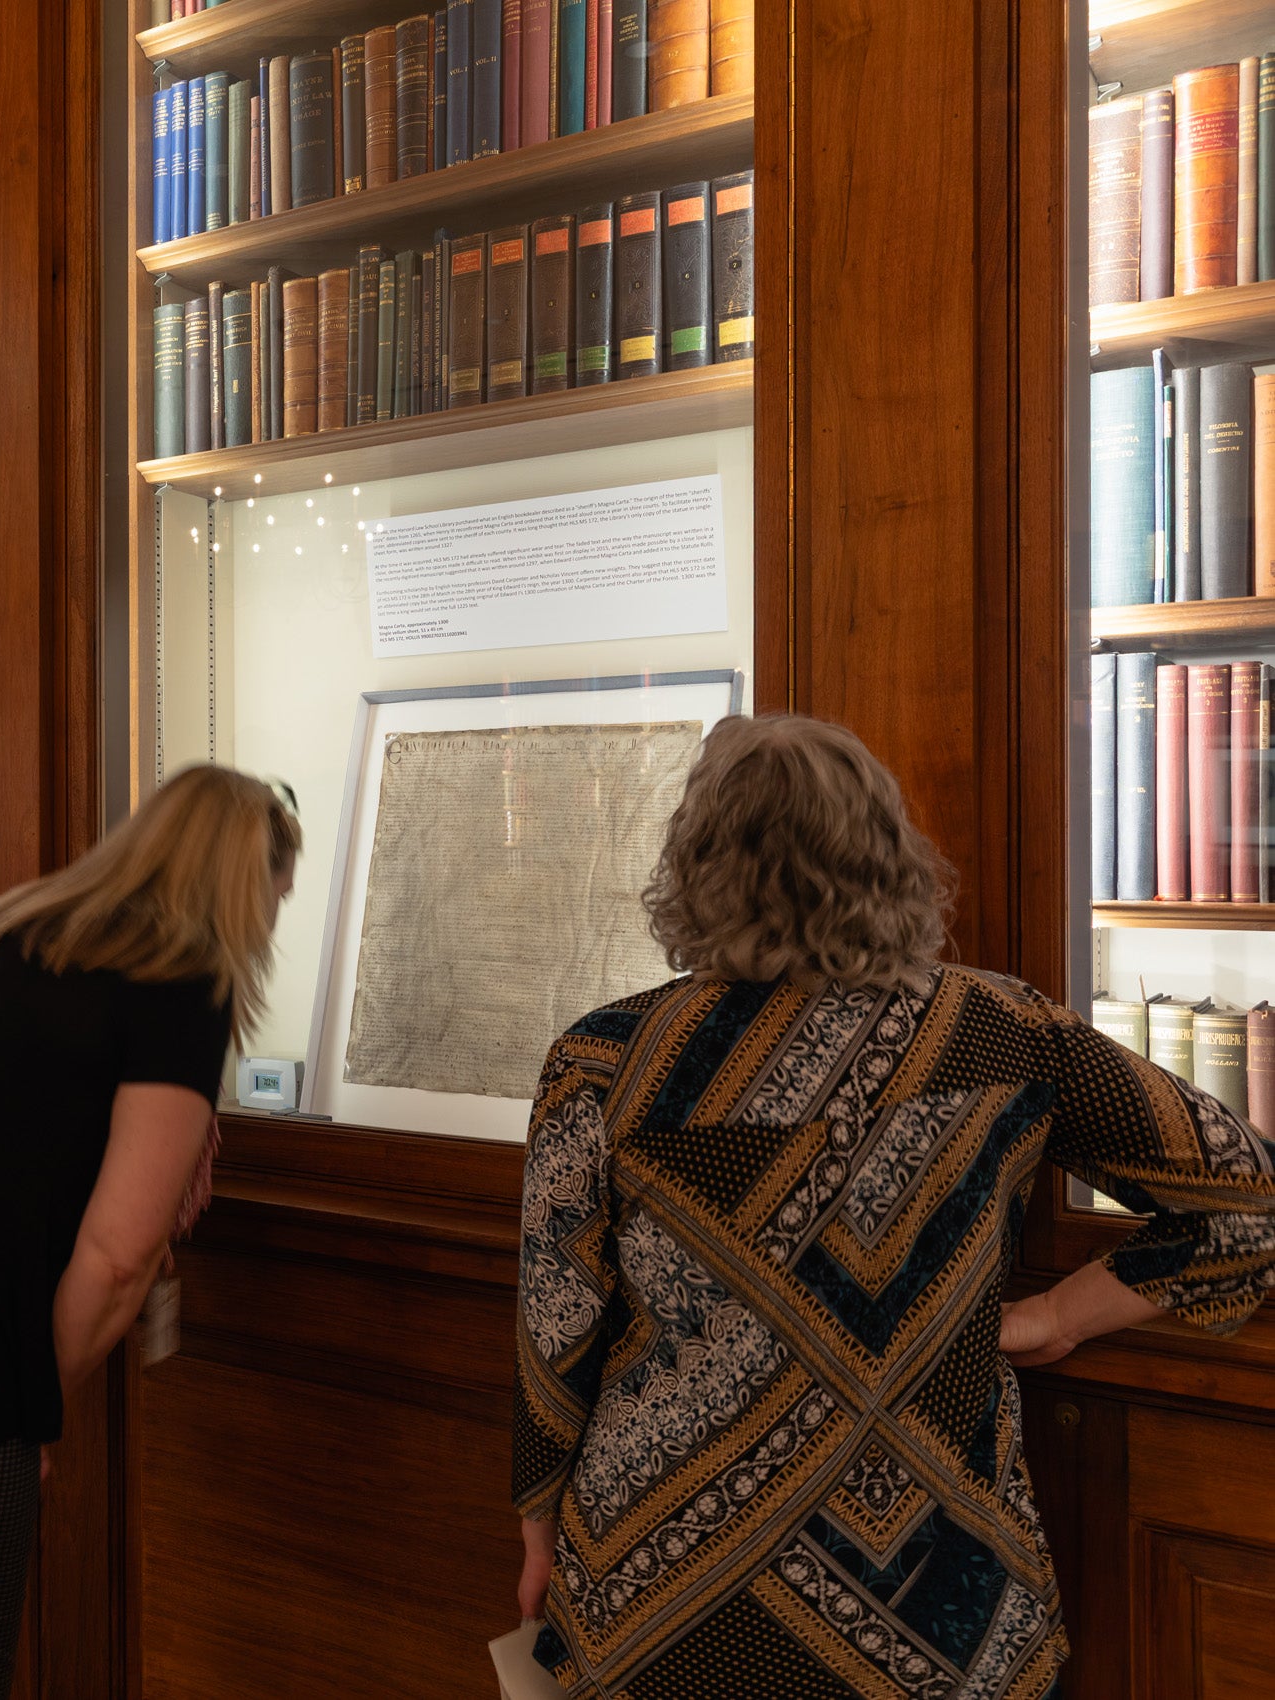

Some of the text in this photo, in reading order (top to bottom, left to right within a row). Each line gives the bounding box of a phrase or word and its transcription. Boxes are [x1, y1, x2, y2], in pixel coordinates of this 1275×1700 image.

[292, 75, 324, 90] MAYNE
[312, 89, 333, 100] LAW
[293, 108, 322, 122] USAGE
[1208, 421, 1239, 431] FILOSOFIA
[1198, 1031, 1246, 1046] JURISPRUDENCE
[1204, 1059, 1239, 1067] HOLLAND
